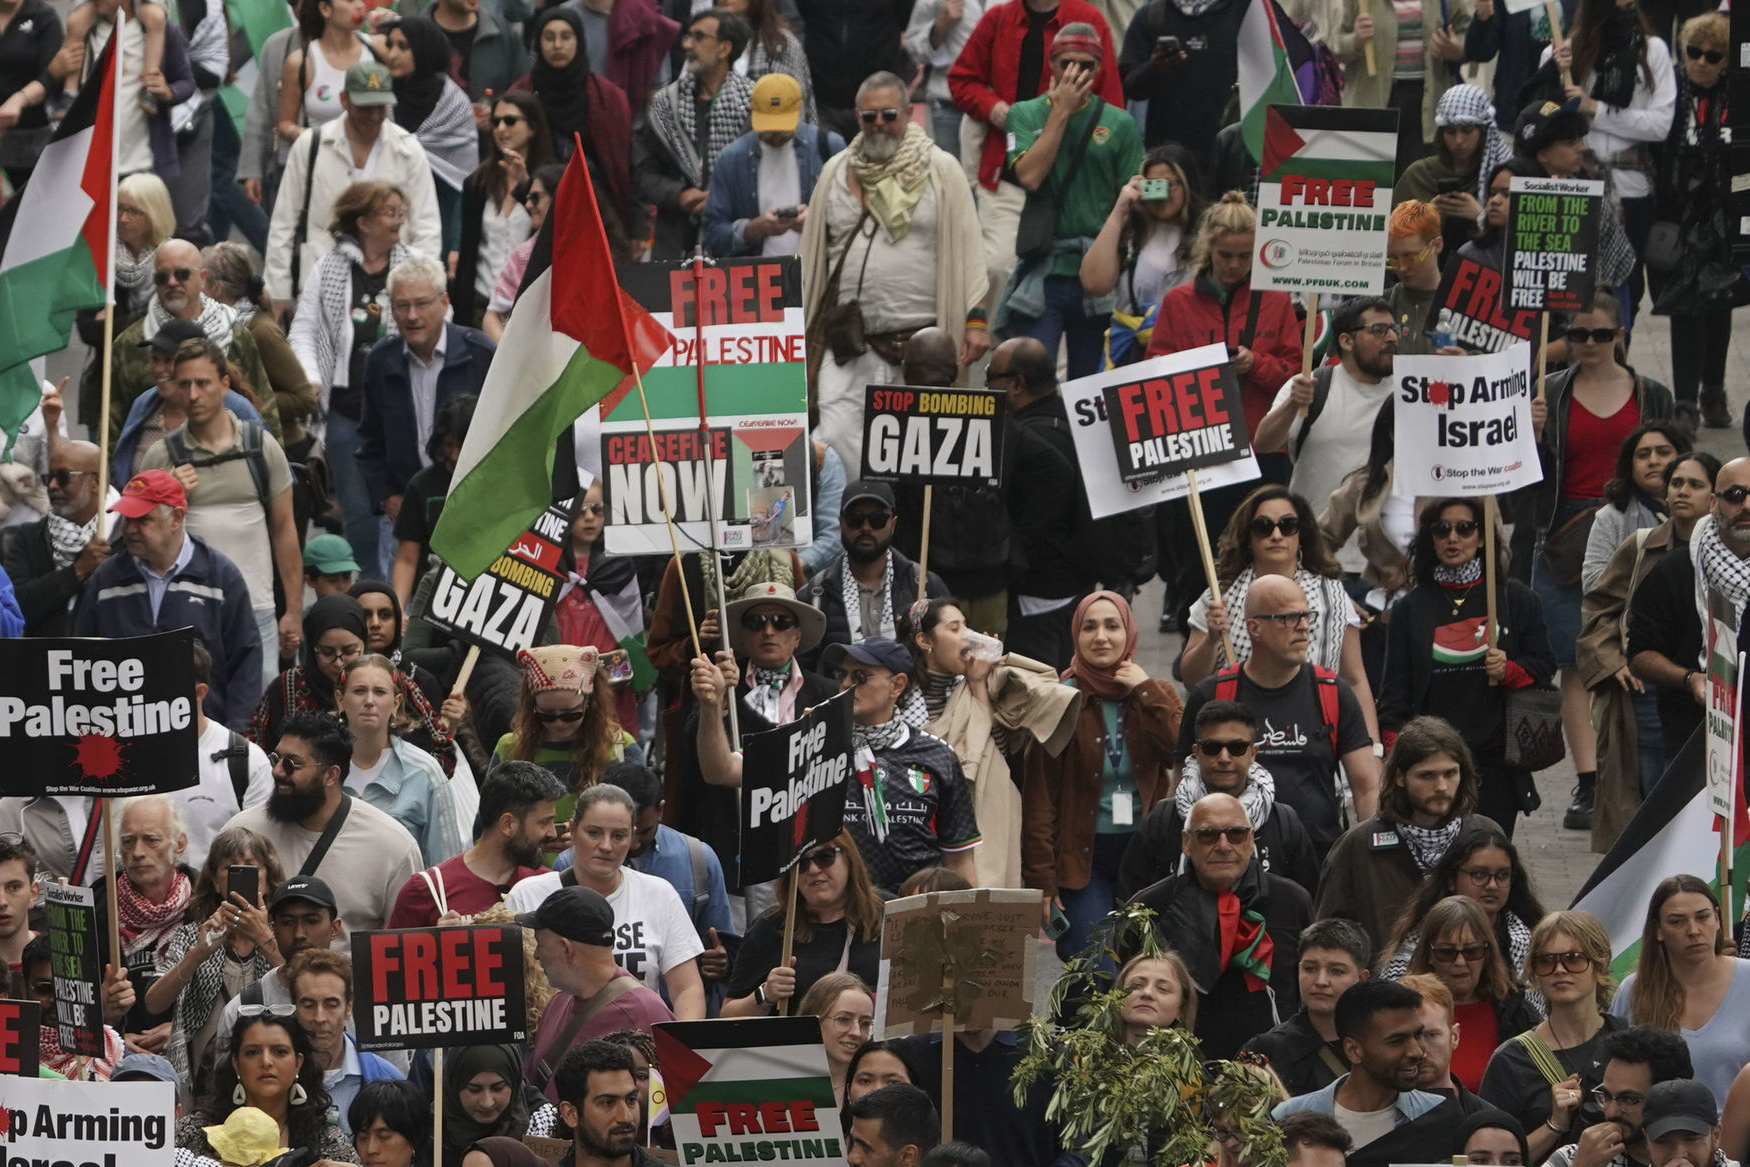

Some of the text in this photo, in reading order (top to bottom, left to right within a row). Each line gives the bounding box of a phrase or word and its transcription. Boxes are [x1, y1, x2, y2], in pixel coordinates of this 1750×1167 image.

[1280, 174, 1376, 208] FREE
[1518, 194, 1589, 216] FROM THE
[1261, 208, 1386, 232] PALESTINE
[1517, 213, 1580, 234] RIVER TO
[1514, 250, 1588, 272] PALESTINE
[1516, 232, 1571, 252] THE SEA
[670, 263, 784, 328] FREE
[1272, 275, 1369, 289] WWW.PFBUK.COM
[1511, 288, 1544, 308] FREE
[1512, 269, 1568, 290] WILL BE
[873, 390, 996, 416] STOP BOMBING
[1117, 367, 1230, 443] FREE
[868, 413, 993, 477] GAZA
[1438, 405, 1518, 448] Israel
[1129, 423, 1234, 470] PALESTINE
[609, 458, 727, 525] NOW
[490, 556, 555, 598] BOMBING
[432, 566, 545, 651] GAZA
[47, 649, 145, 692] Free
[788, 720, 827, 774] Free
[750, 752, 848, 829] Palestine
[68, 907, 87, 932] THE
[370, 928, 506, 1003] FREE
[54, 976, 95, 1005] PALESTINE
[58, 1023, 77, 1050] FREE
[373, 998, 507, 1037] PALESTINE
[32, 1104, 166, 1150] Arming
[695, 1100, 820, 1138] FREE
[682, 1138, 843, 1165] PALESTINE
